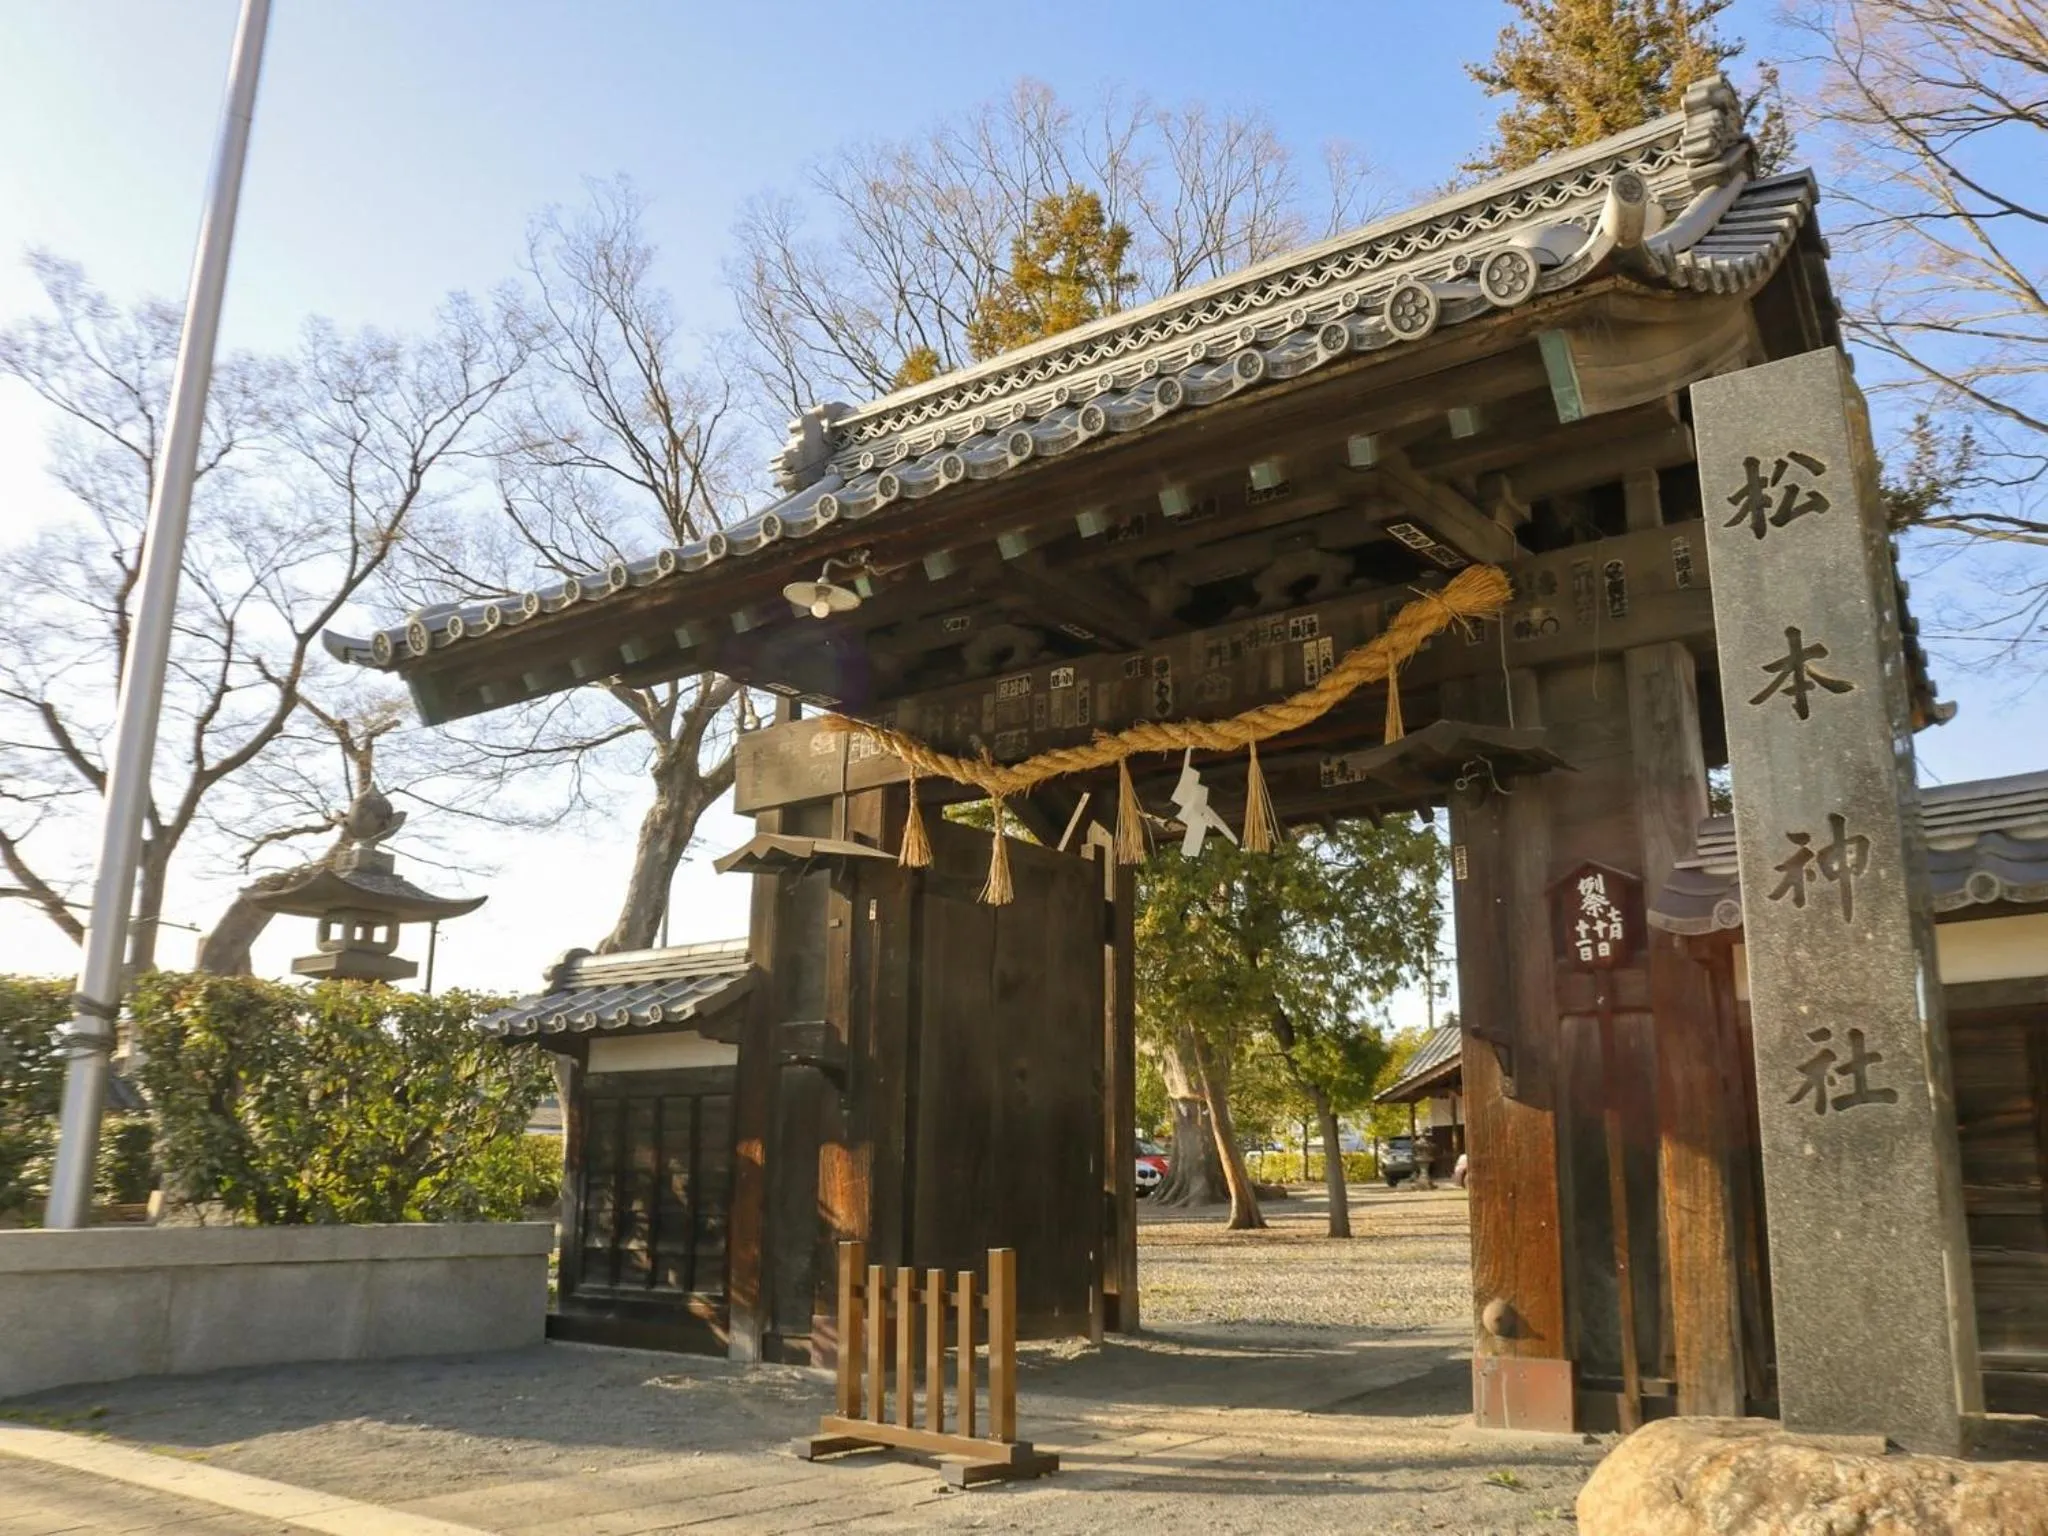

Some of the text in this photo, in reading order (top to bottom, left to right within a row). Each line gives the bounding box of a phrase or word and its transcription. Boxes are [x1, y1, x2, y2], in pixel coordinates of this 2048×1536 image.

[1723, 450, 1899, 1115] 松本神社
[1577, 873, 1611, 918] 例祭
[1575, 919, 1593, 961] 十一日
[1592, 919, 1610, 957] 十日
[1606, 906, 1624, 940] 七月
